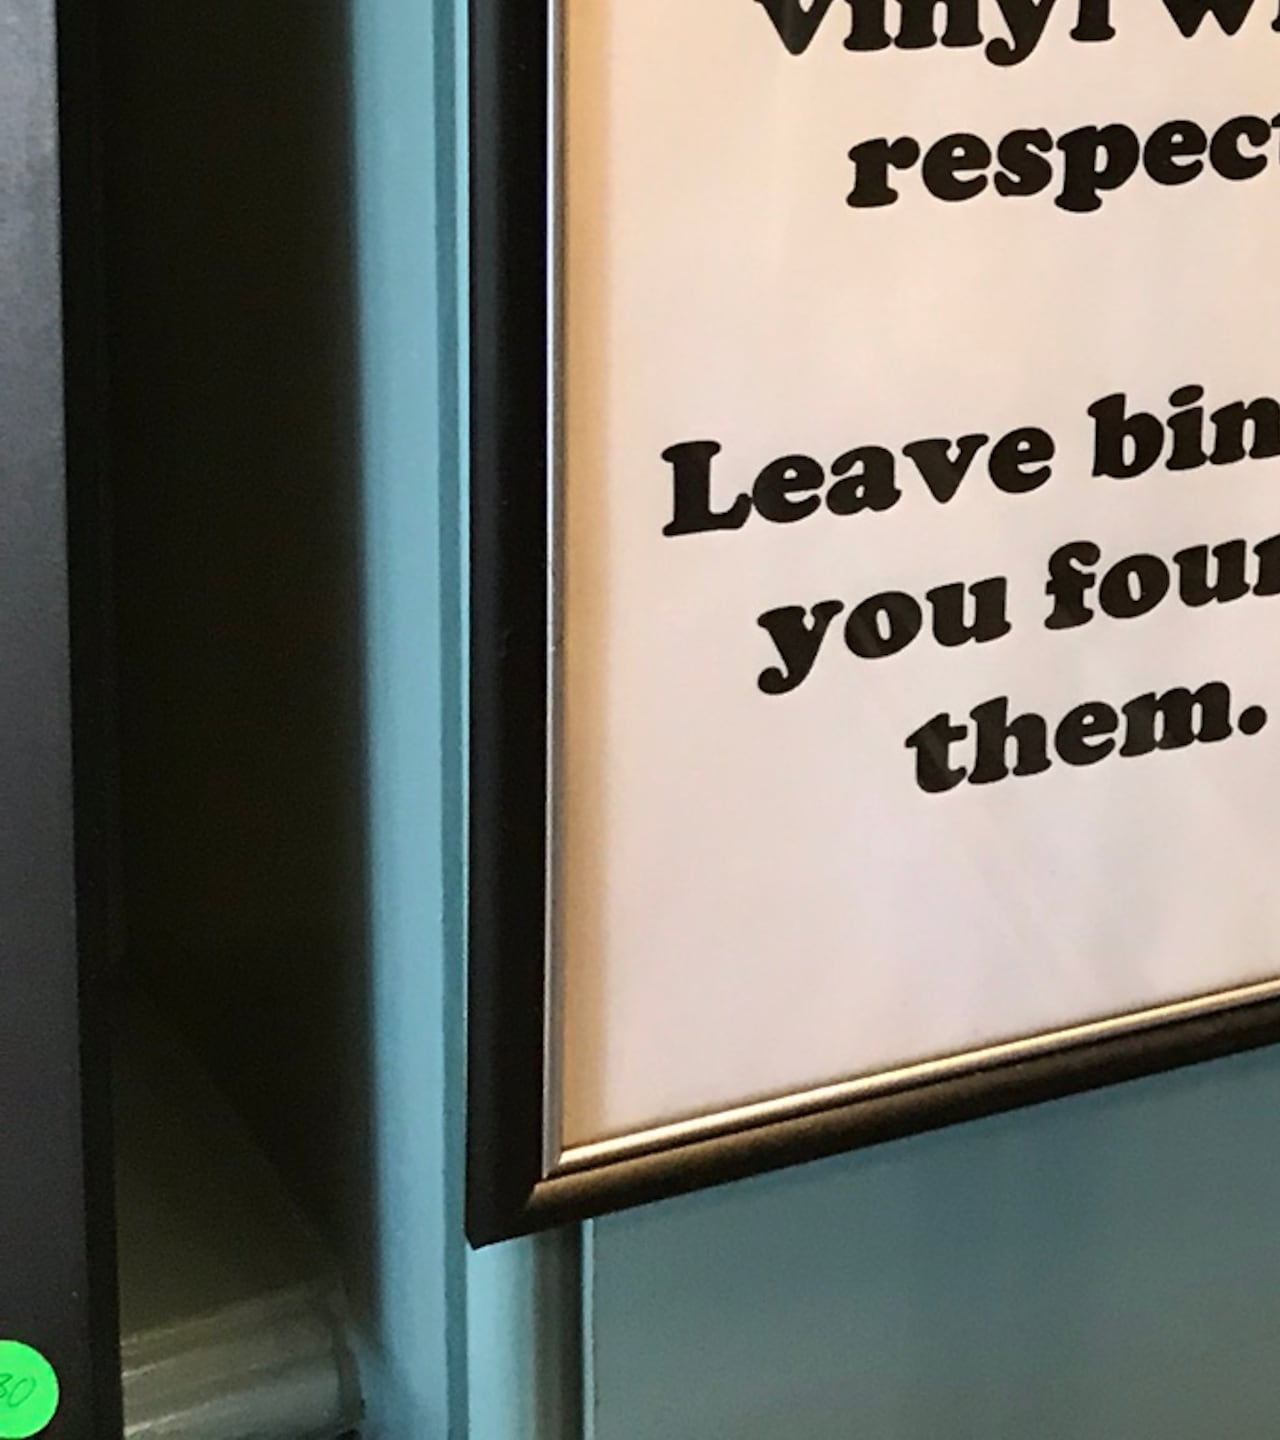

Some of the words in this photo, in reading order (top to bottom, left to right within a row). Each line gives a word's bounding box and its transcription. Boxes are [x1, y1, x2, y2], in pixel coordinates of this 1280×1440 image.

[661, 426, 1056, 537] Leave
[756, 574, 1012, 696] you
[905, 679, 1269, 794] them.
